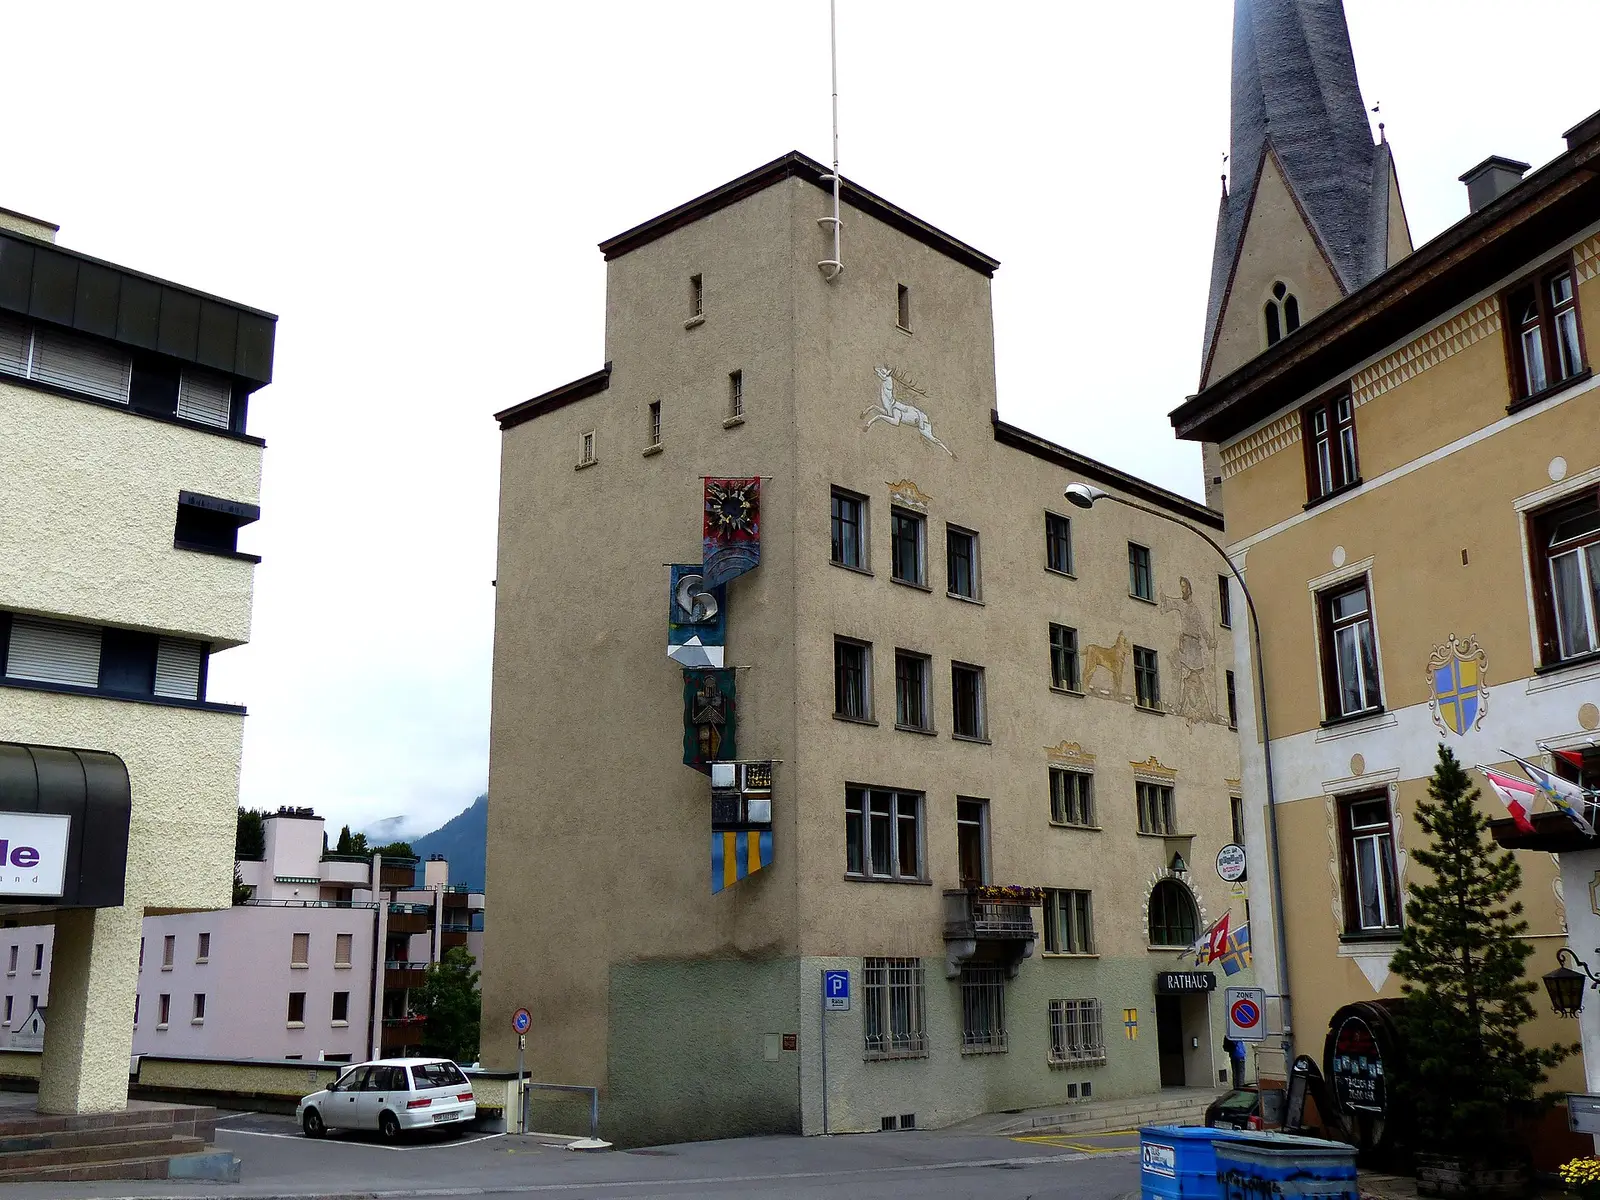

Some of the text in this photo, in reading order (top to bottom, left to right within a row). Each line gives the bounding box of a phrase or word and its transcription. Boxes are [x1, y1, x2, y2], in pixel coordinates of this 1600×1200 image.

[833, 979, 842, 995] P
[1167, 974, 1208, 989] RATHAUS
[1236, 991, 1254, 999] ZONE
